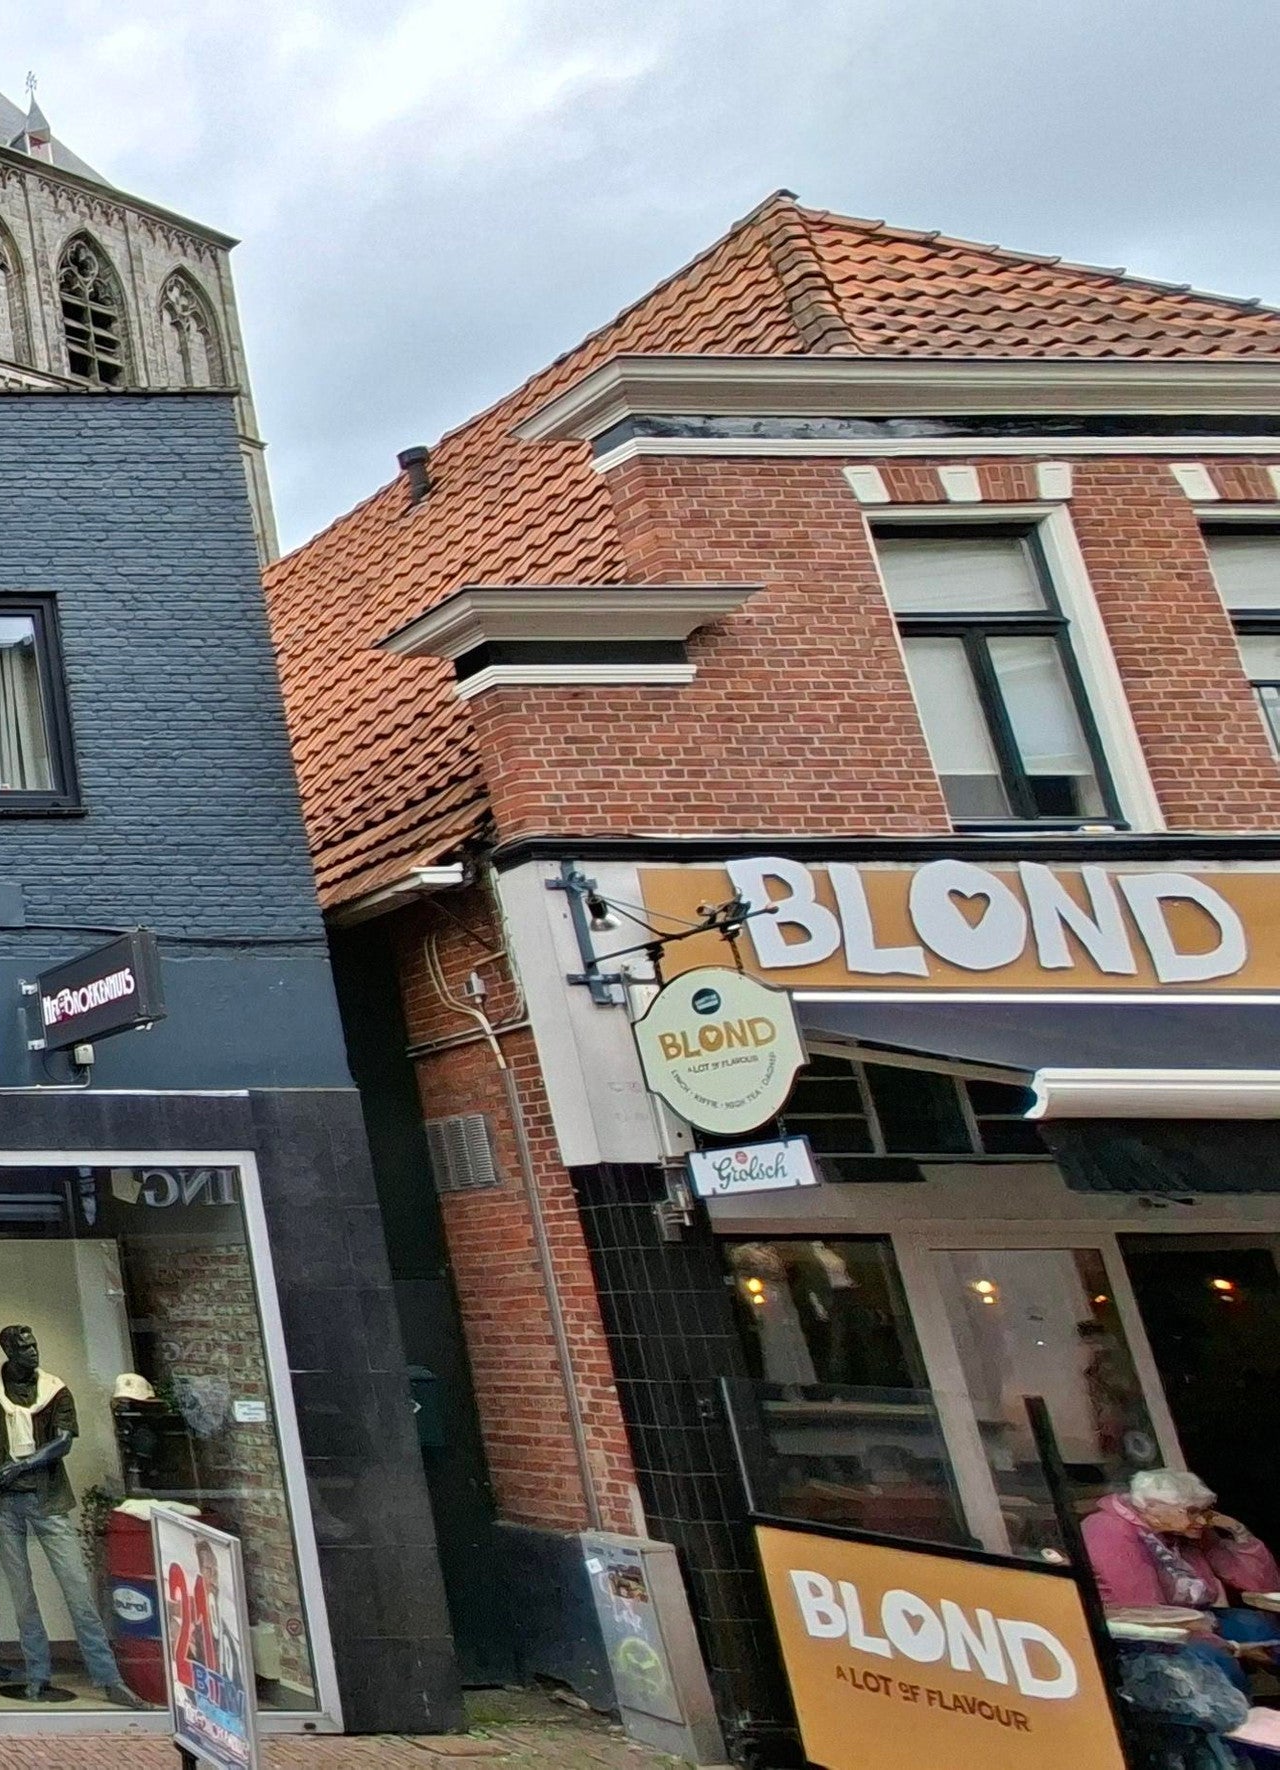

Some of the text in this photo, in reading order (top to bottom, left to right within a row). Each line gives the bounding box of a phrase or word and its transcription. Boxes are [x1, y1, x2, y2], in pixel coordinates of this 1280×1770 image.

[725, 856, 1248, 983] BLOND
[657, 1016, 778, 1061] BLOND
[693, 1062, 710, 1074] LOT
[712, 1151, 788, 1190] Grolsch
[789, 1569, 1078, 1699] BLOND
[836, 1665, 1032, 1733] A LOT OF FLAVOUR
